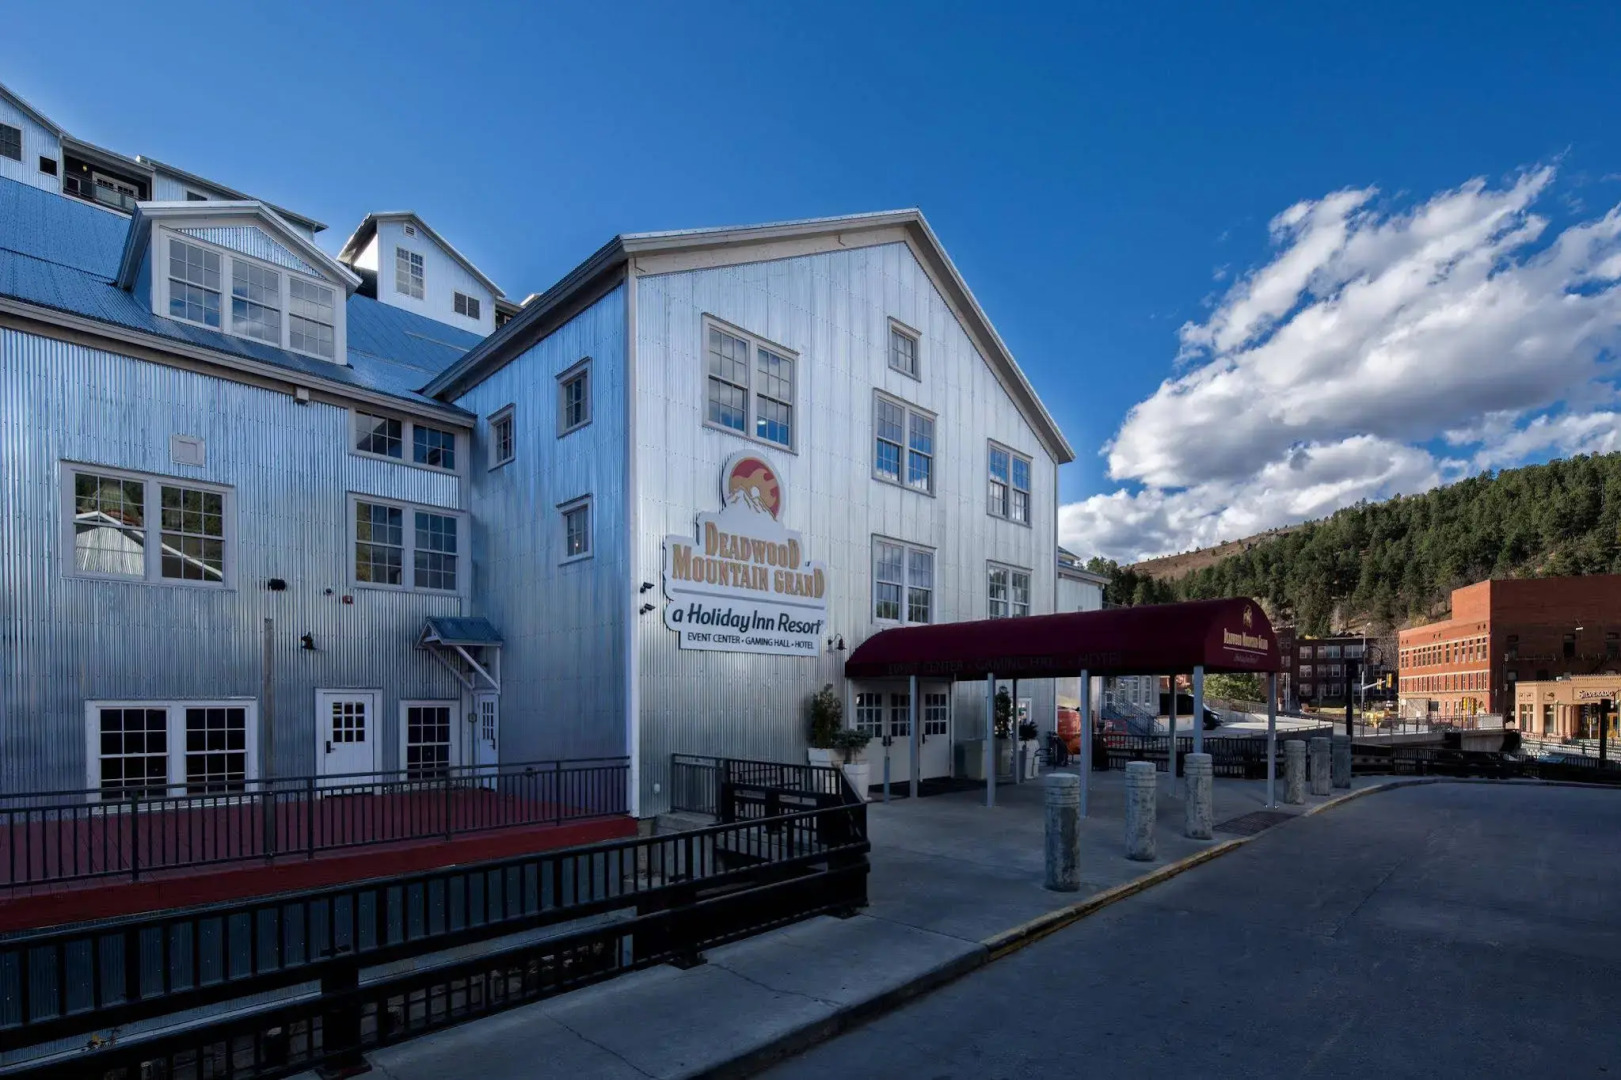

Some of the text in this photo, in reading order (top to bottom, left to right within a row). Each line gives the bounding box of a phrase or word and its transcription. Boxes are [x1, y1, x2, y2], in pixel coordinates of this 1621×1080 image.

[705, 521, 800, 570] DEADWOOD
[672, 543, 825, 599] MOUNTAIN GRAND
[672, 602, 822, 635] a Holiday Inn Resort
[687, 632, 815, 650] EVENT CENTER GAMING HALL HOTEL
